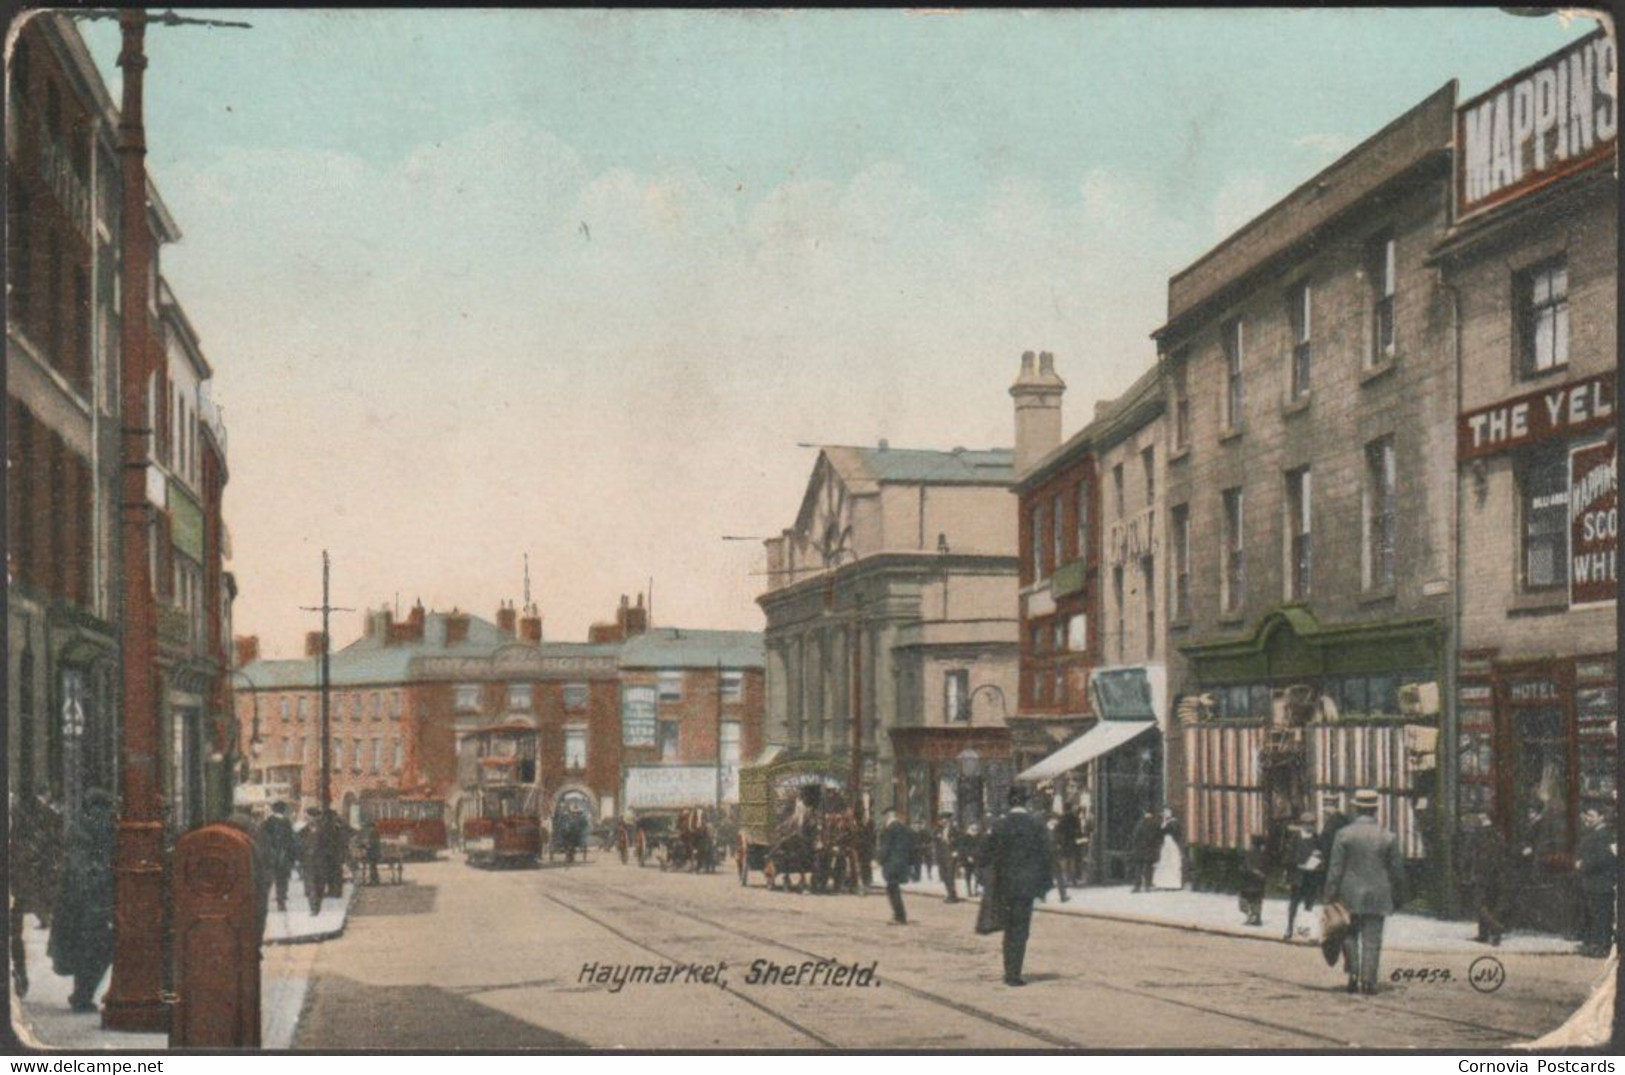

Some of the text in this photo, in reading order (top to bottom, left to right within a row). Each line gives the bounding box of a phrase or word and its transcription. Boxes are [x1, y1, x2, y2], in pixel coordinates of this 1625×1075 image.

[1465, 36, 1616, 204] MAPPIN'S
[1468, 381, 1612, 448] THE YEL
[1511, 683, 1559, 700] HOTEL
